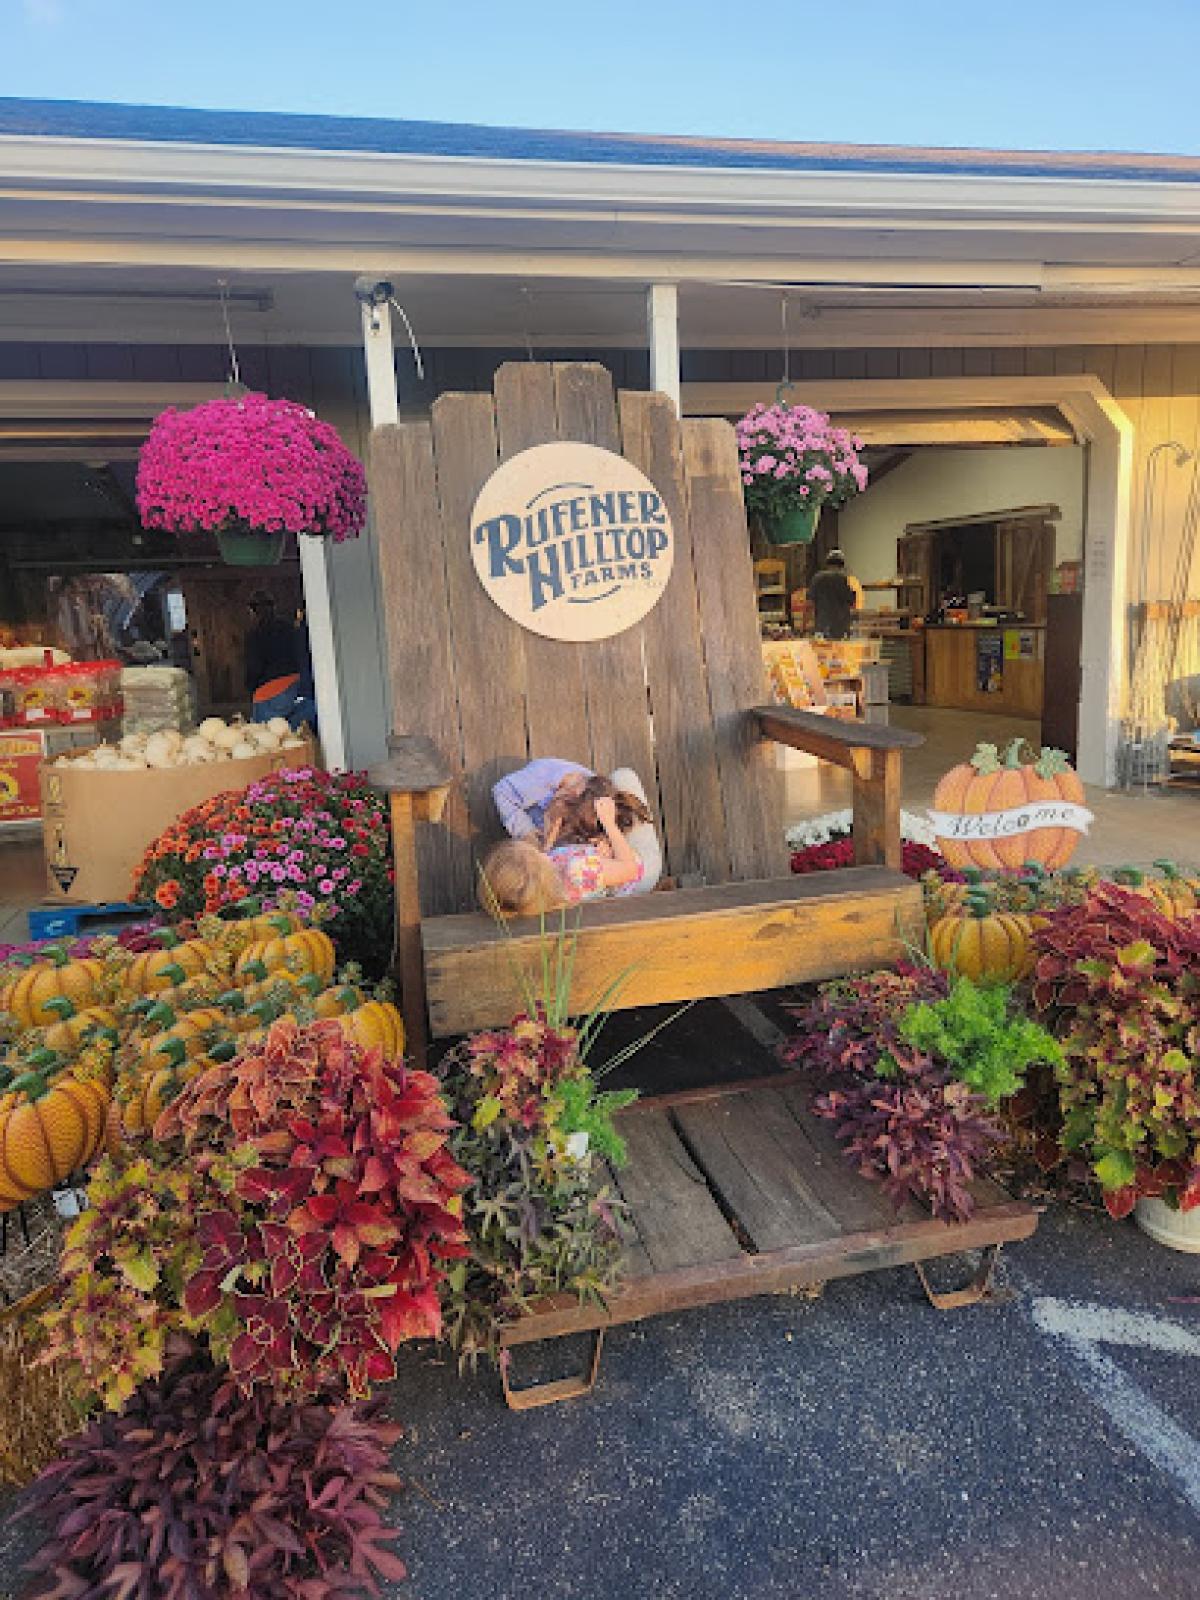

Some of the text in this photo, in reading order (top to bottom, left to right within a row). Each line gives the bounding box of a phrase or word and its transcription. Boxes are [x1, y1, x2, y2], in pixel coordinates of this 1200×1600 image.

[474, 491, 666, 577] RUFENER
[526, 528, 669, 612] HILLTOP
[570, 562, 654, 589] FARMS
[948, 808, 1074, 836] Welcome
